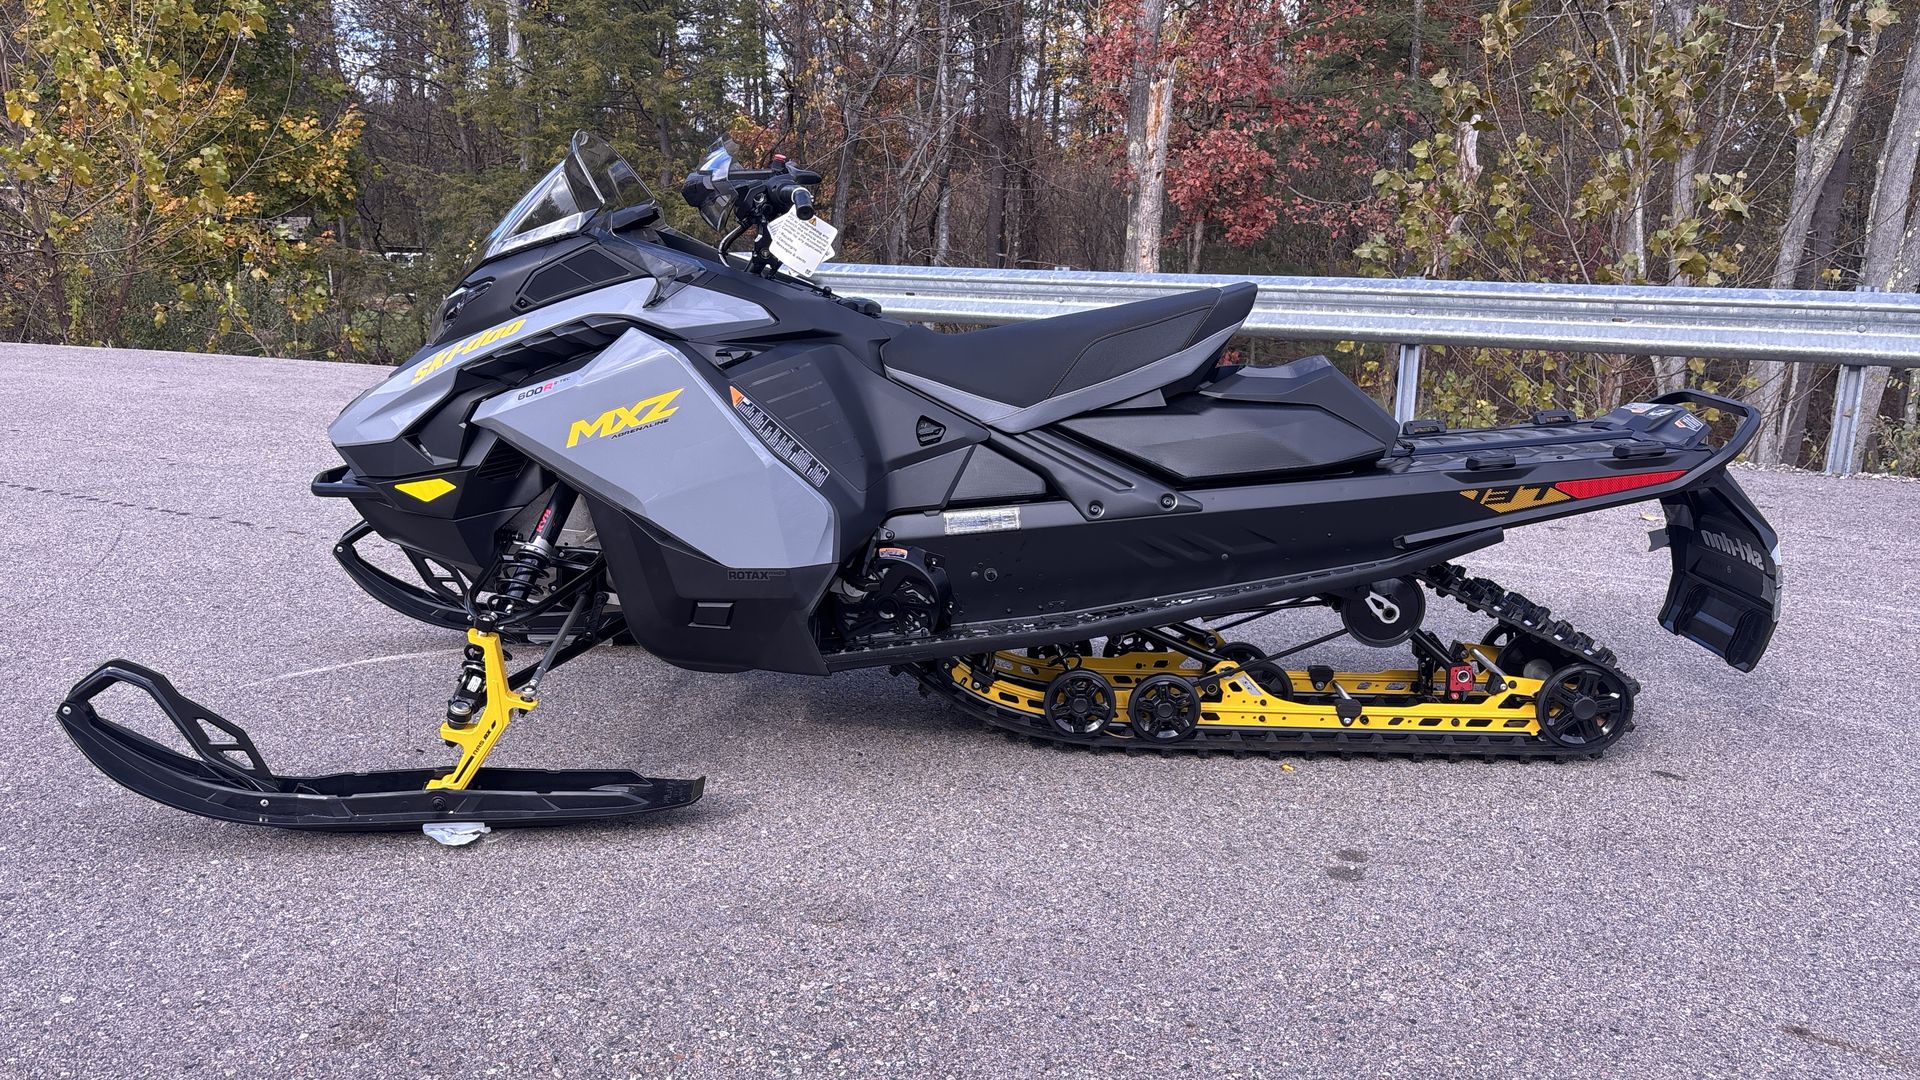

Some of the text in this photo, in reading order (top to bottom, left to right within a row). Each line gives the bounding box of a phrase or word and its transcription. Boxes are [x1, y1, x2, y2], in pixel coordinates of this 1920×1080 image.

[566, 387, 685, 448] MXZ
[611, 418, 670, 440] ADRENALINE
[728, 571, 769, 580] ROTAX
